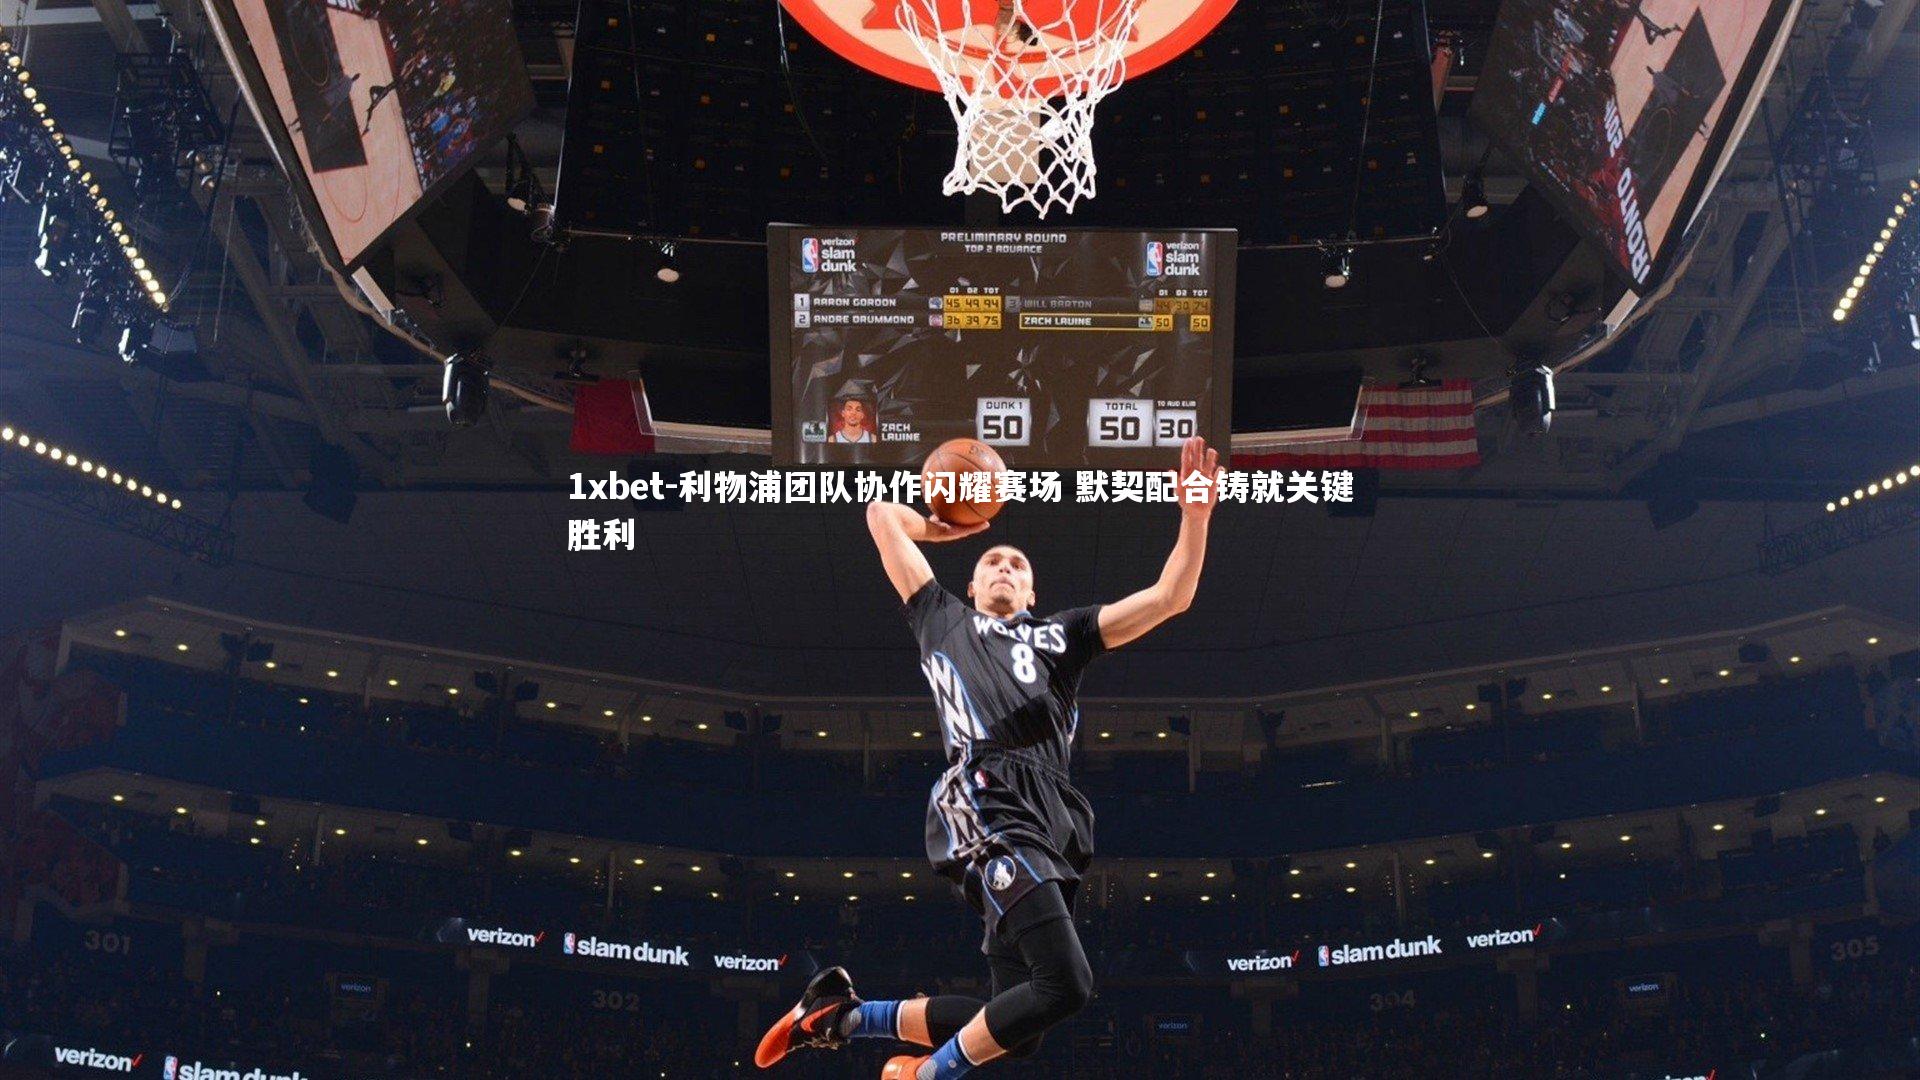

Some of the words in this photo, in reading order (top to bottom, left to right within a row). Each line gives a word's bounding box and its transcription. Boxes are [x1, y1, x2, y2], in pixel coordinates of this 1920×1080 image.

[1618, 167, 1650, 284] RONTO
[821, 238, 855, 246] verizon
[941, 232, 1021, 243] PRELIMINARY
[1025, 233, 1067, 243] ROUND
[965, 244, 983, 253] TOP
[986, 245, 992, 253] 2
[996, 245, 1042, 254] ADVANCE
[1166, 242, 1199, 250] verizon
[821, 247, 855, 259] slam
[1165, 251, 1199, 263] slam
[821, 260, 857, 272] dunk
[1165, 264, 1200, 276] dunk
[813, 298, 850, 307] AARON
[853, 298, 897, 307] GORDON
[946, 298, 960, 308] 45
[966, 299, 980, 308] 49
[983, 299, 999, 308] 94
[1024, 300, 1047, 308] WILL
[798, 315, 806, 324] 2
[814, 315, 849, 324] ANDRE
[852, 315, 914, 324] DRUMMOND
[947, 315, 960, 325] 36
[966, 315, 980, 325] 39
[984, 316, 999, 325] 75
[1024, 317, 1052, 325] ZACH
[1055, 317, 1091, 325] LAVINE
[1156, 318, 1169, 327] 50
[1193, 318, 1207, 327] 50
[986, 401, 1015, 410] DUNK
[1019, 402, 1023, 410] 1
[1105, 402, 1138, 411] TOTAL
[882, 423, 911, 432] ZACH
[983, 415, 1023, 439] 50
[1100, 416, 1140, 440] 50
[1159, 419, 1194, 438] 30
[882, 432, 920, 442] LAVINE
[1011, 643, 1037, 683] 8
[84, 930, 132, 955] 301
[468, 928, 535, 947] verizon
[1467, 928, 1534, 948] verizon
[577, 937, 631, 959] slam
[633, 942, 689, 966] dunk
[1331, 944, 1384, 965] slam
[1385, 935, 1442, 959] dunk
[1831, 935, 1880, 961] 305
[714, 954, 778, 971] verizon
[1227, 953, 1292, 971] verizon
[340, 983, 372, 993] verizon
[1628, 982, 1659, 992] verizon
[592, 989, 640, 1012] 302
[1370, 989, 1417, 1012] 304
[1157, 1021, 1188, 1031] verizon
[55, 1047, 132, 1072] verizon
[179, 1061, 245, 1080] slam
